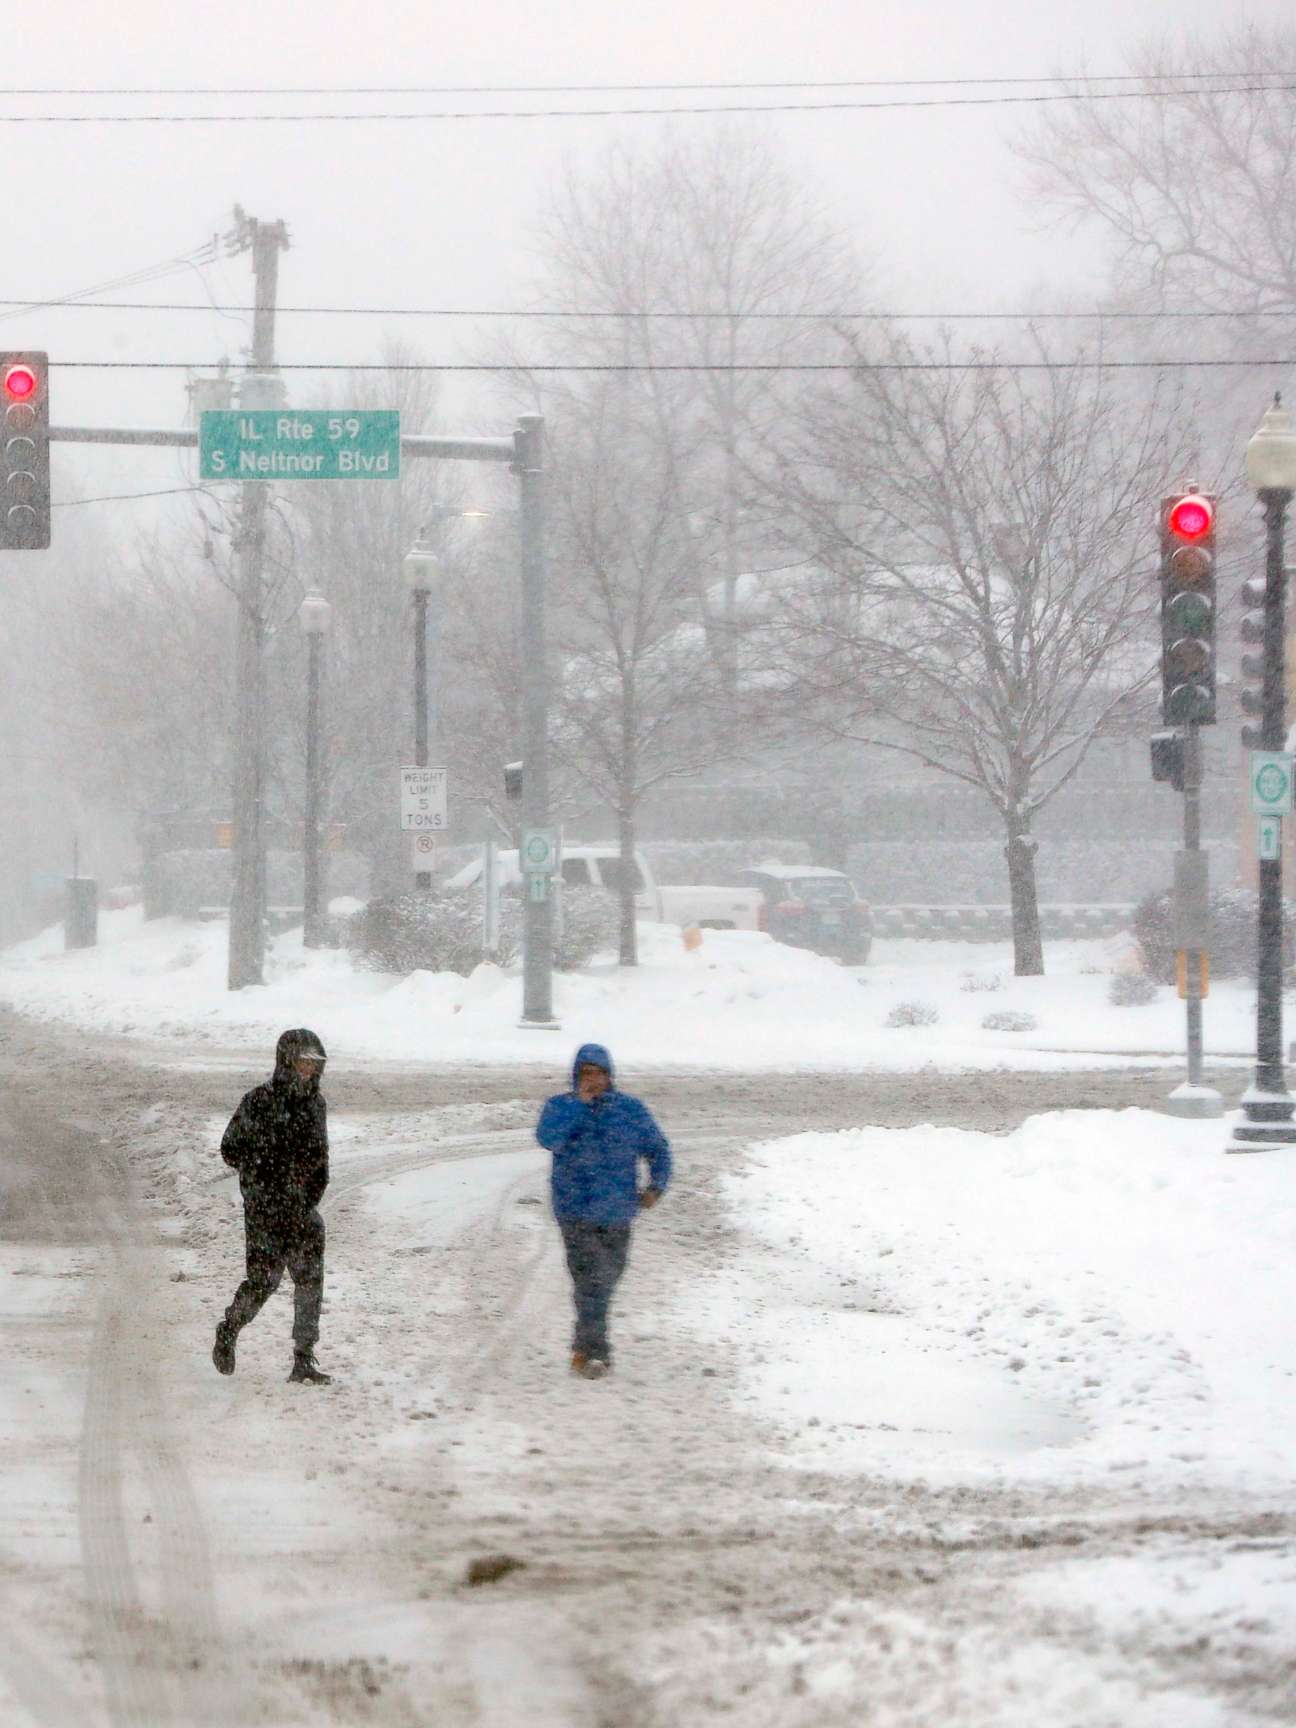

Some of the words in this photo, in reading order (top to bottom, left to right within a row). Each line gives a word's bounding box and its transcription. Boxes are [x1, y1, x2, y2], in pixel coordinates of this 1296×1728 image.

[240, 418, 262, 439] IL
[277, 418, 313, 440] Rte
[327, 418, 360, 440] 59
[211, 450, 225, 471] S
[240, 450, 324, 471] Neltnor
[339, 450, 389, 471] Blvd
[404, 772, 443, 783] WEIGHT
[409, 784, 438, 795] LIMIT
[418, 798, 428, 810] 5
[407, 814, 442, 826] TONS
